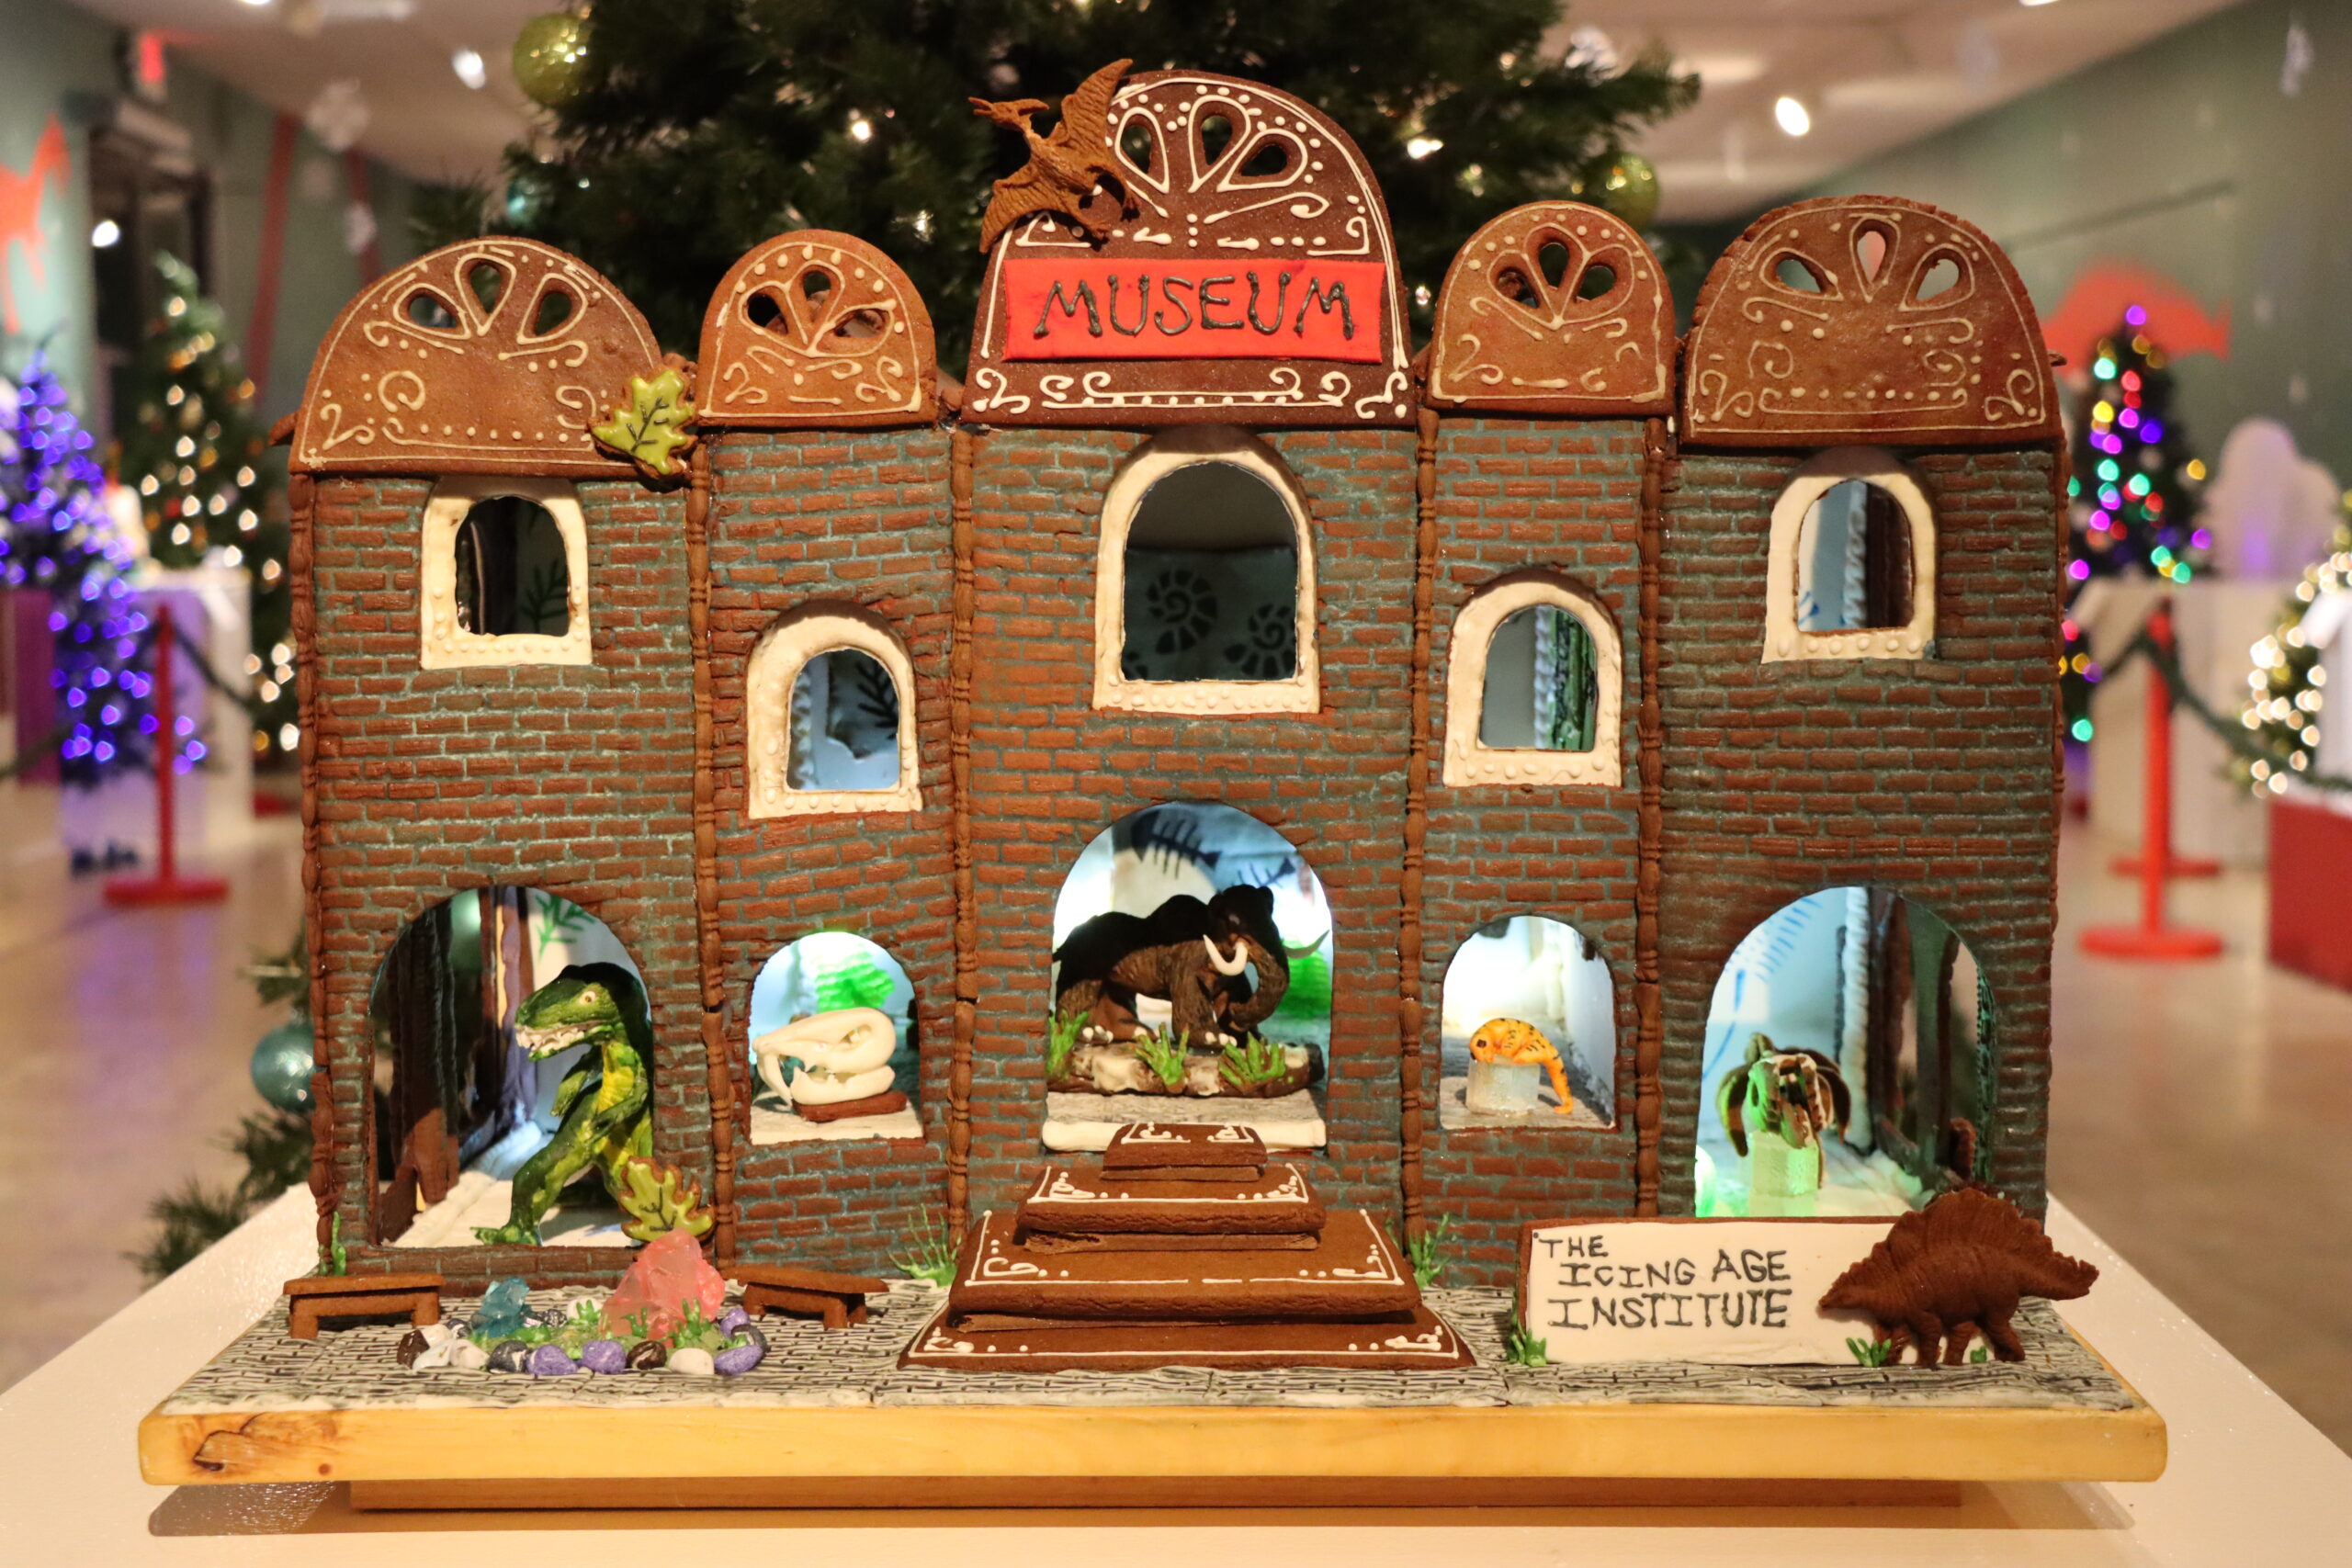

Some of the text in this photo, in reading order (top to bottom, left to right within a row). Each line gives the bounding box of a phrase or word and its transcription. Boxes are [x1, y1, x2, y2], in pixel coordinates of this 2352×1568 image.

[1033, 271, 1354, 340] MUSEUM
[1539, 1235, 1609, 1258] THE
[1557, 1248, 1792, 1288] ICING AGE
[1547, 1288, 1792, 1330] INSTITUTE
